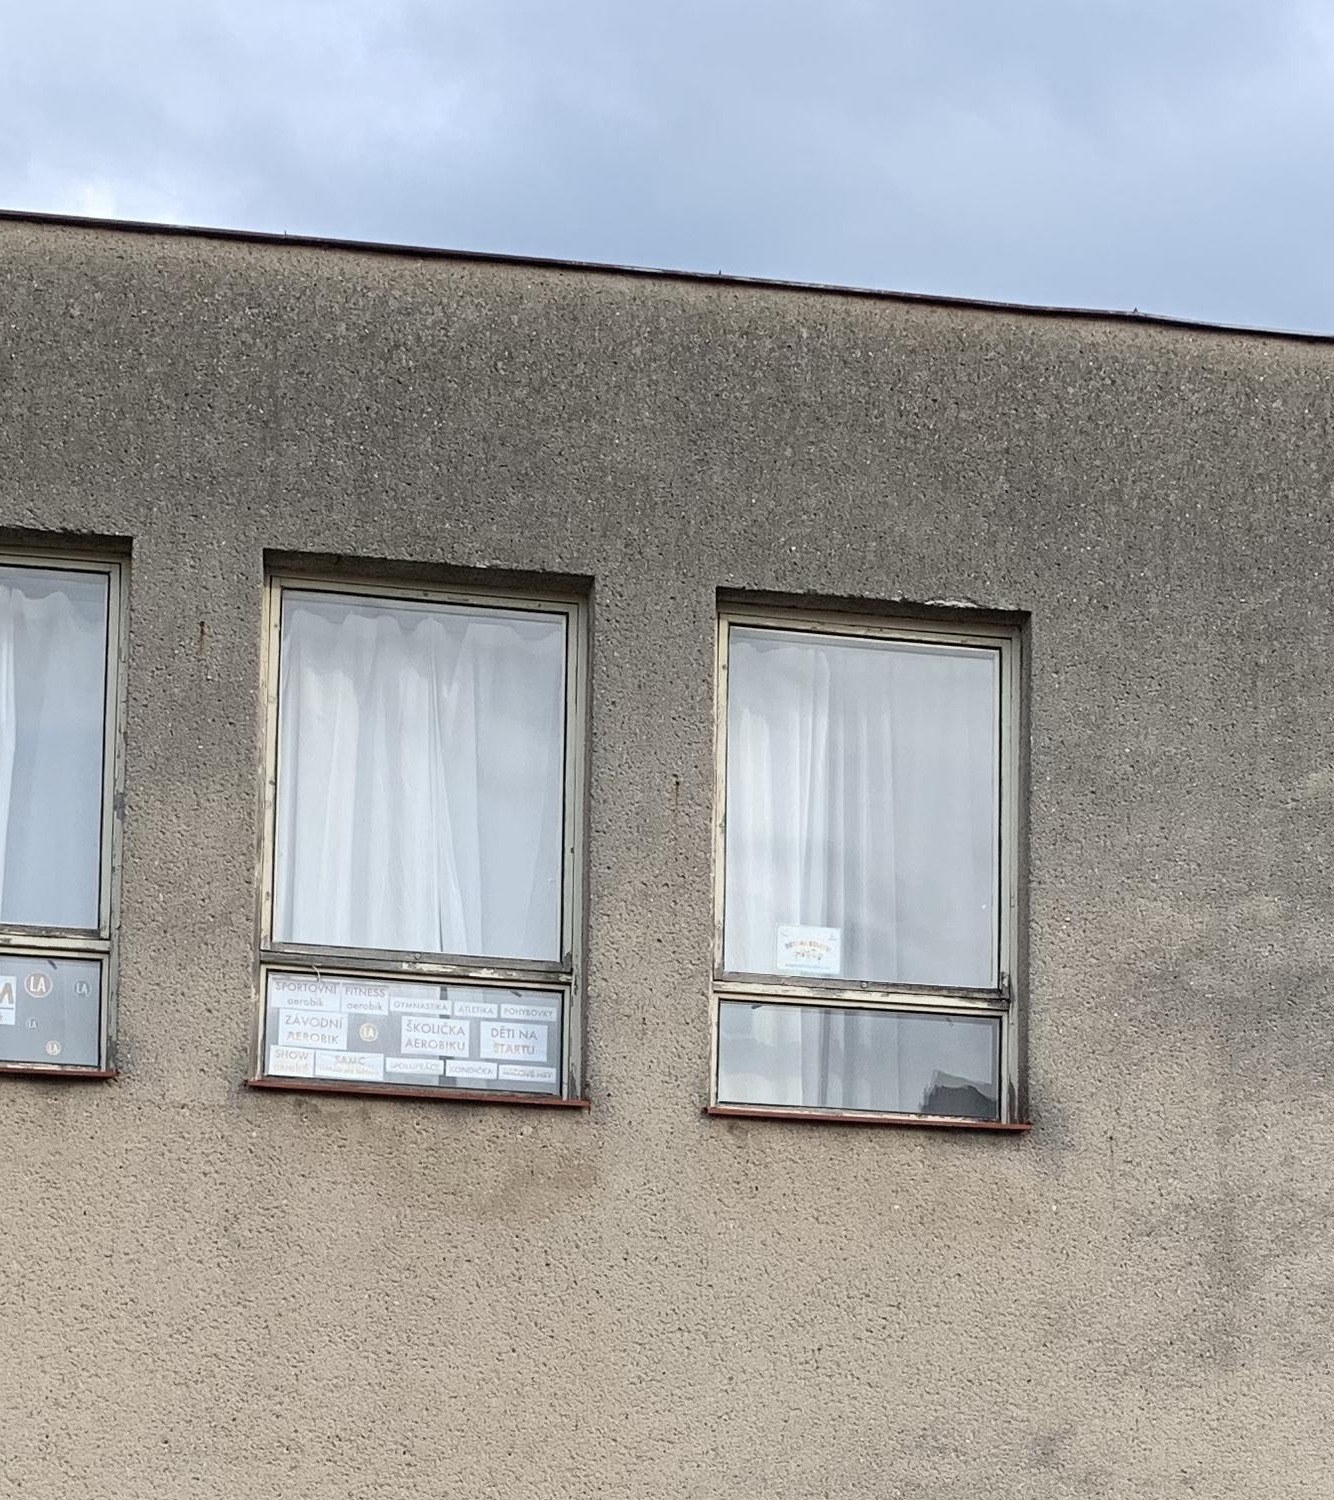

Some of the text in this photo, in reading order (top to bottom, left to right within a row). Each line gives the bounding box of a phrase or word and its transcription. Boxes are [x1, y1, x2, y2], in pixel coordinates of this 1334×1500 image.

[345, 986, 386, 998] FITNESS
[287, 998, 323, 1008] aerobik
[346, 1001, 383, 1011] aerobik
[393, 1000, 448, 1011] GYMNASTIKA
[458, 1005, 494, 1015] ATLETIKA
[284, 1014, 343, 1029] ZÁVODNÍ
[405, 1019, 466, 1036] ŠKOLIČKA
[286, 1031, 339, 1045] AEROBIK
[490, 1025, 539, 1041] DĚTI NA
[405, 1038, 465, 1051] AEROBIKU
[493, 1042, 535, 1054] STARTU
[275, 1050, 309, 1061] SHOW
